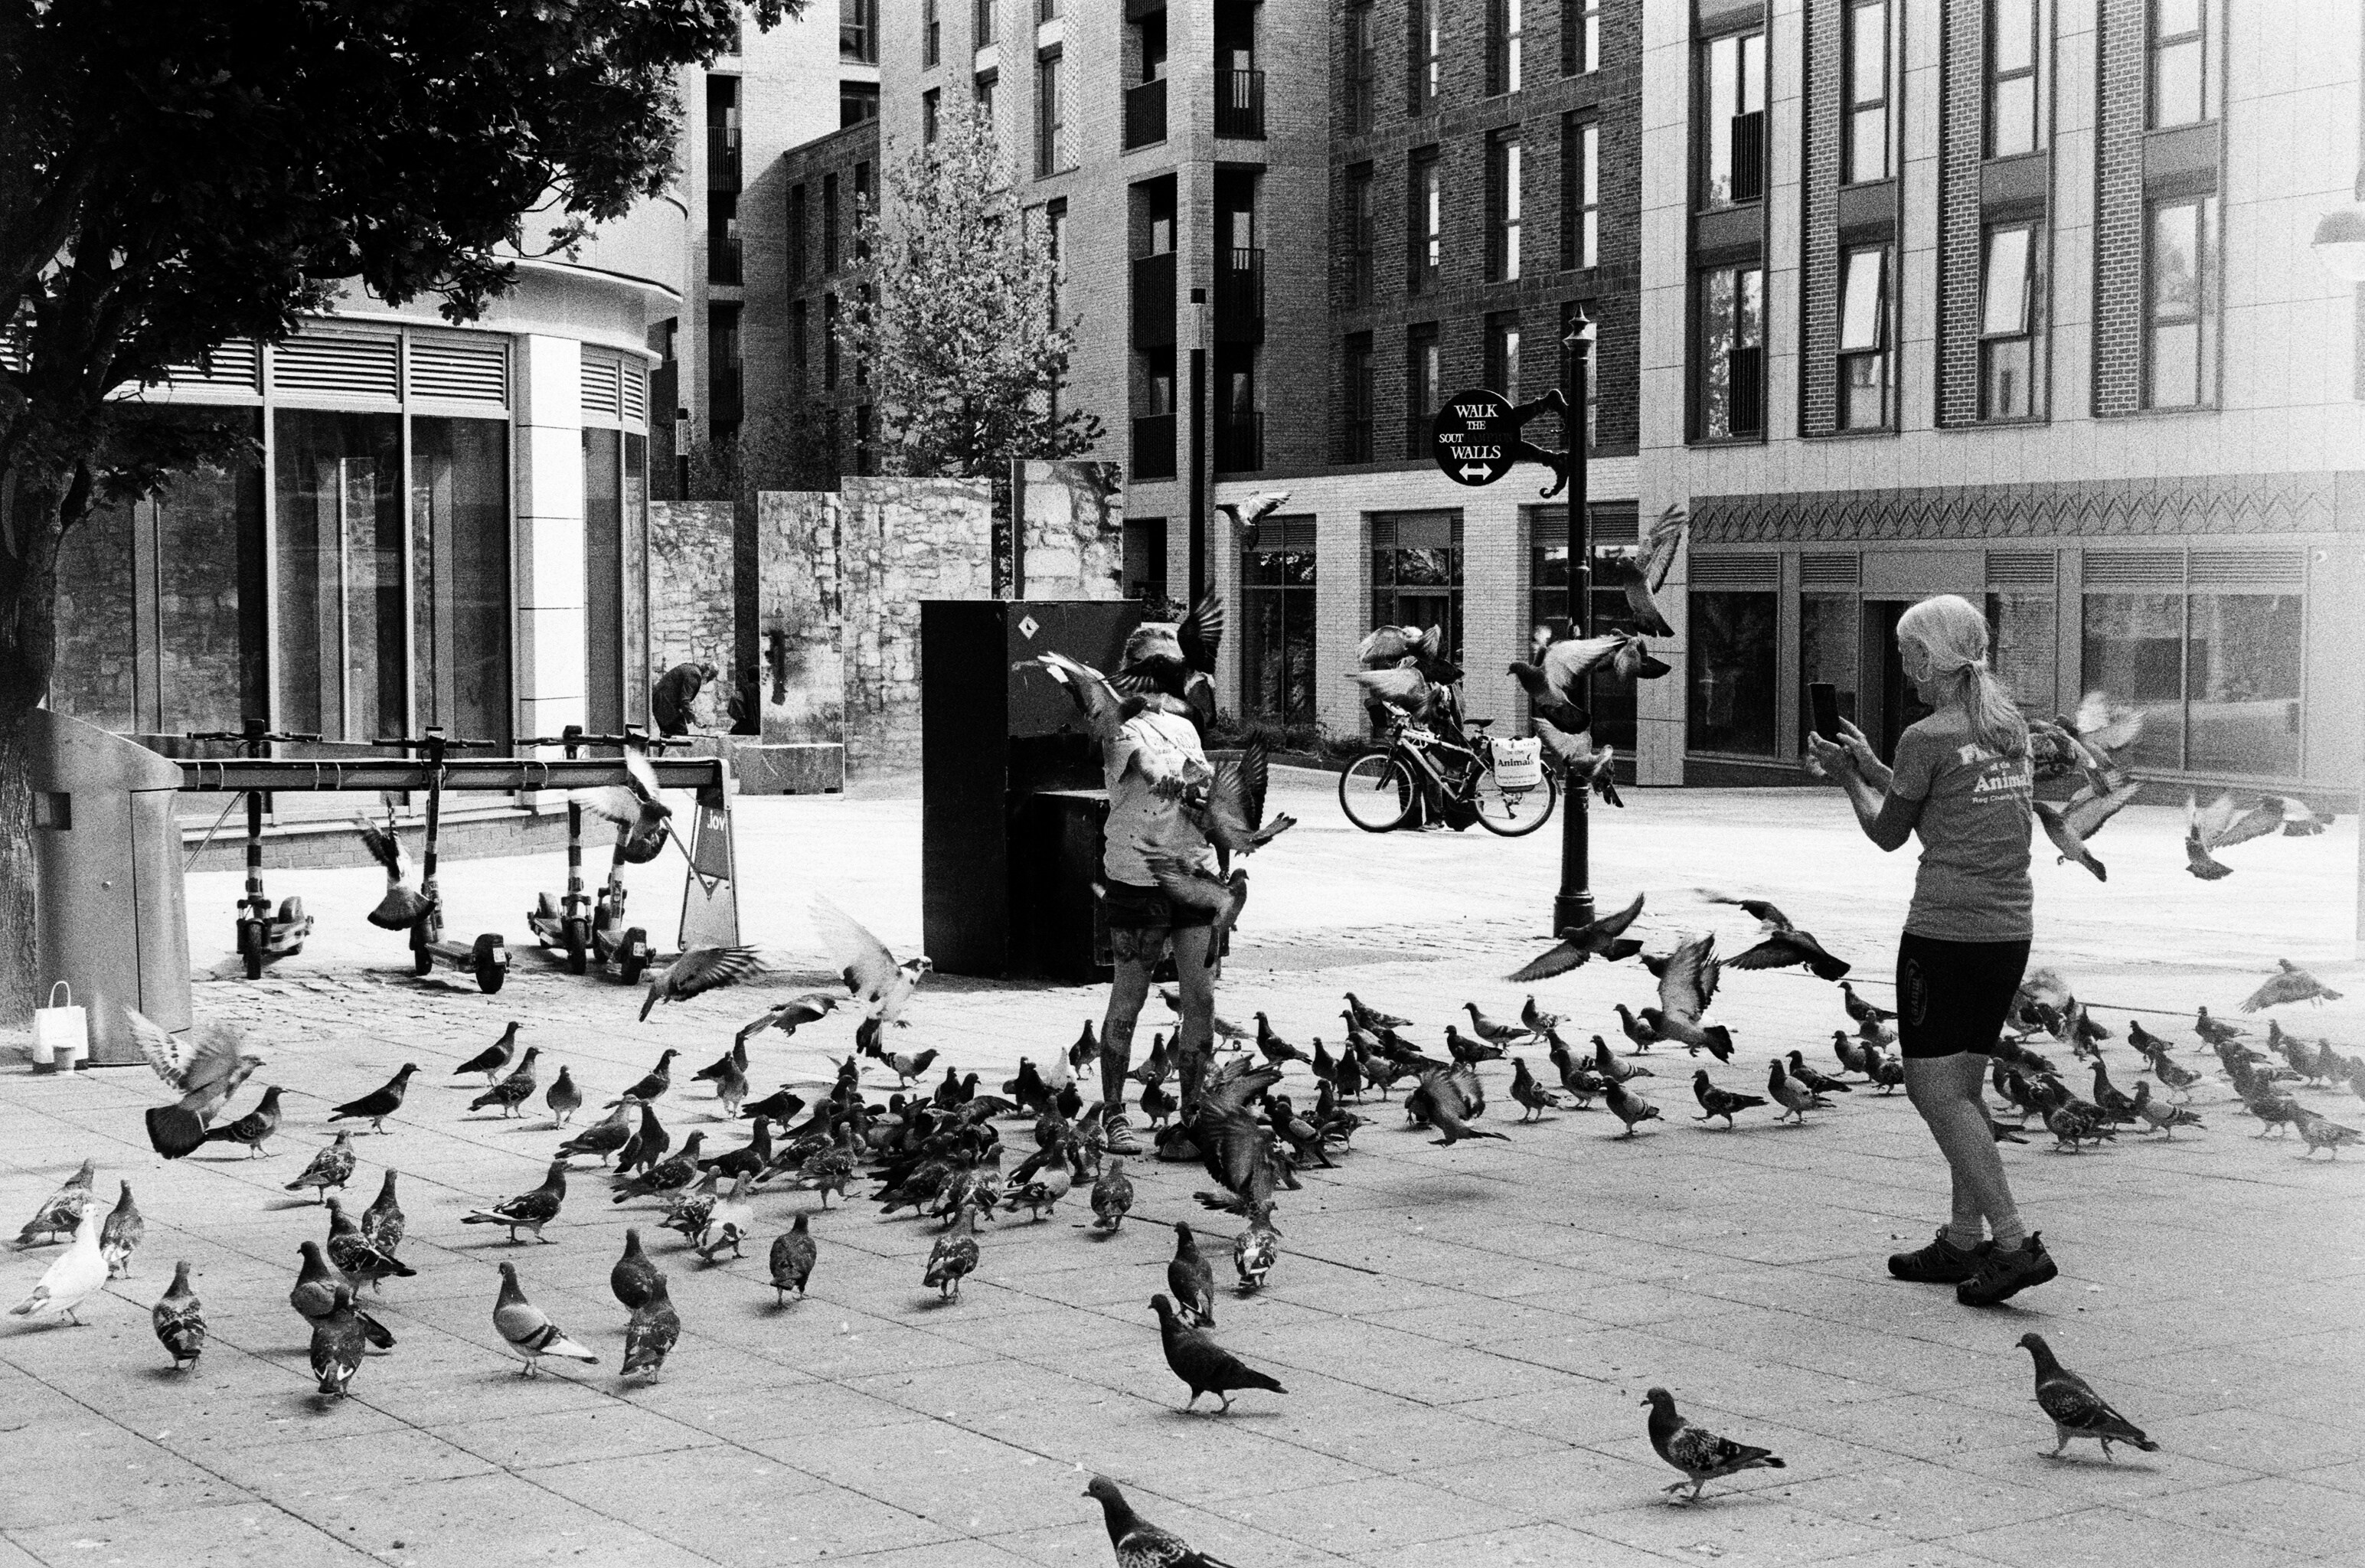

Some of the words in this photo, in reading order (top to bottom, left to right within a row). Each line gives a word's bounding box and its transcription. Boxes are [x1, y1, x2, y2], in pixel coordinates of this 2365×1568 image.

[1454, 404, 1498, 418] WALK
[1466, 420, 1486, 430] THE
[1450, 446, 1501, 459] WALLS
